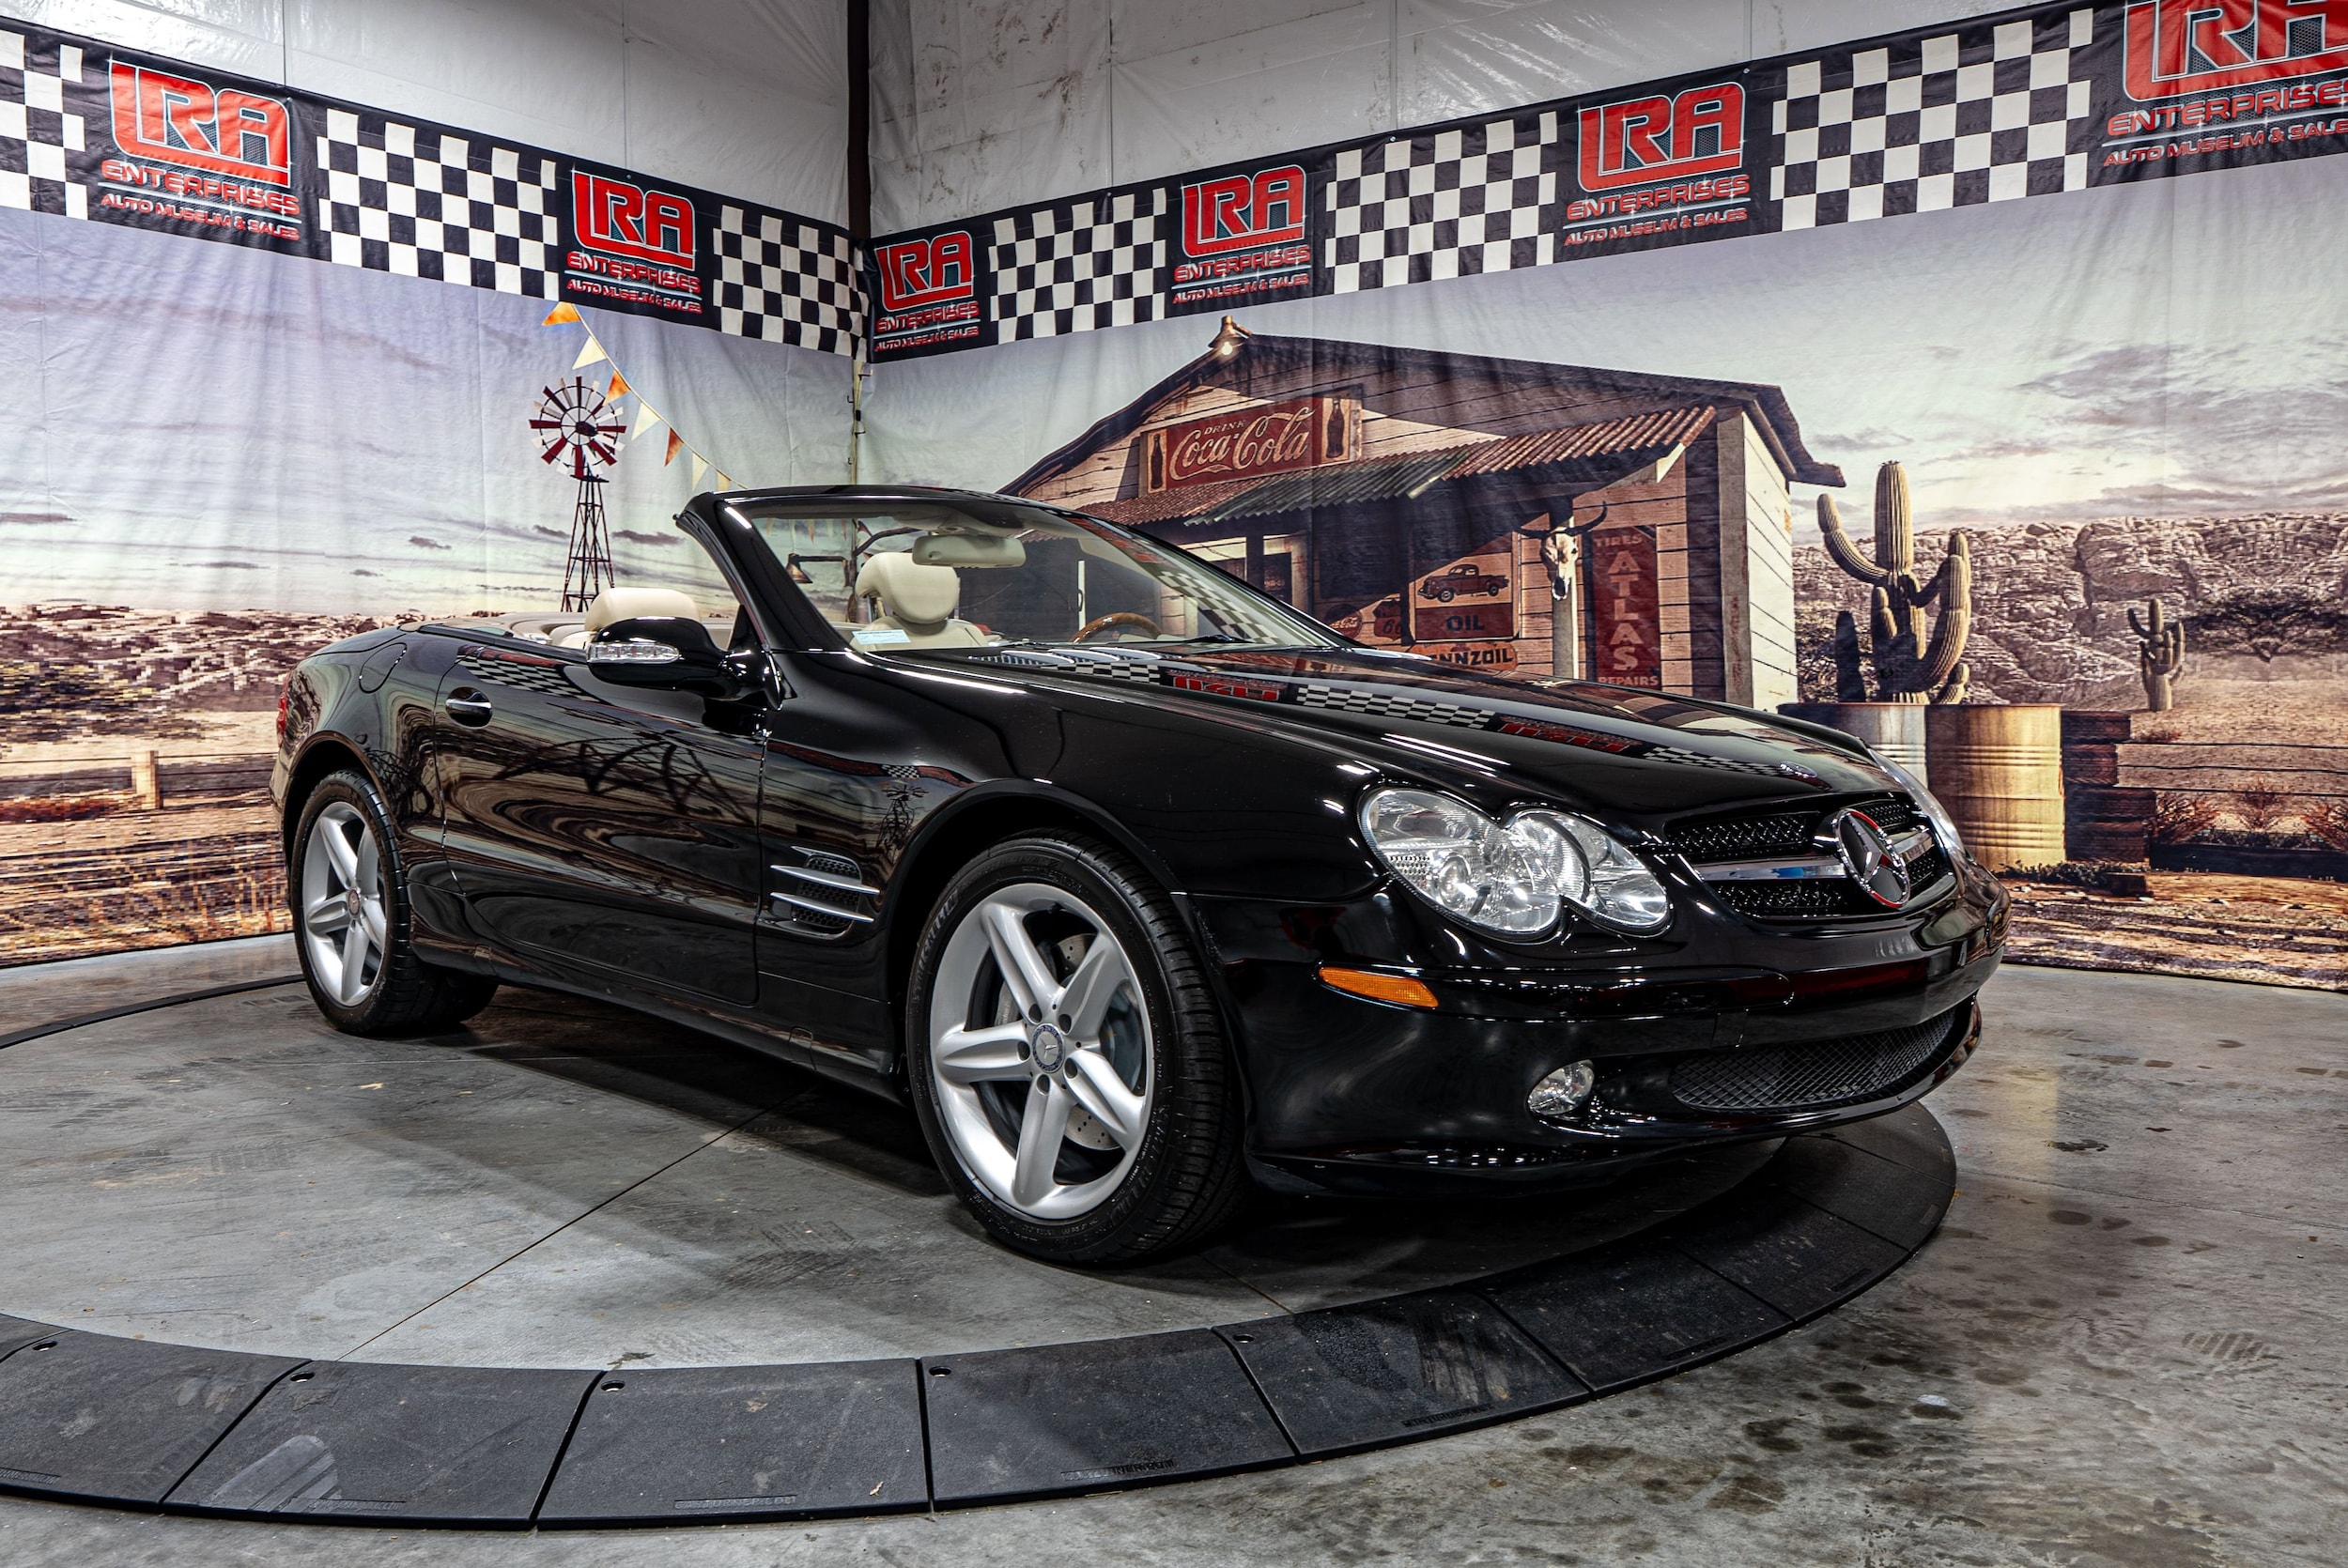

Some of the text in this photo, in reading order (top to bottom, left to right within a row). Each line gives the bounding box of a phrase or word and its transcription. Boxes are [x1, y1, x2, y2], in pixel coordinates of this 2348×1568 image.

[2107, 77, 2348, 136] ENTERPRISE
[2103, 118, 2348, 167] AUTO MUSEUM & SALE
[100, 159, 301, 215] ENTERPRISES
[1567, 174, 1750, 221] ENTERPRISES
[100, 193, 300, 241] AUTO MUSEUM & SALES
[1564, 208, 1748, 246] AUTO MUSEUM & SALES
[566, 251, 702, 294] ENTERPRISES
[1174, 244, 1311, 282] ENTERPRISES
[566, 279, 601, 295] AUTO
[603, 284, 655, 305] MUSEUM
[663, 296, 703, 315] SALES
[1173, 272, 1309, 303] AUTO MUSEUM & SALES
[876, 300, 980, 333] ENTERPRISES
[874, 338, 901, 352] AUTO
[947, 326, 979, 340] SALES
[1204, 420, 1246, 435] DRINK
[1594, 533, 1644, 547] TIRES
[1446, 615, 1486, 631] OIL
[1607, 550, 1645, 670] ATLAS
[1426, 648, 1514, 666] NNZOIL
[1597, 675, 1660, 686] REPAIRS
